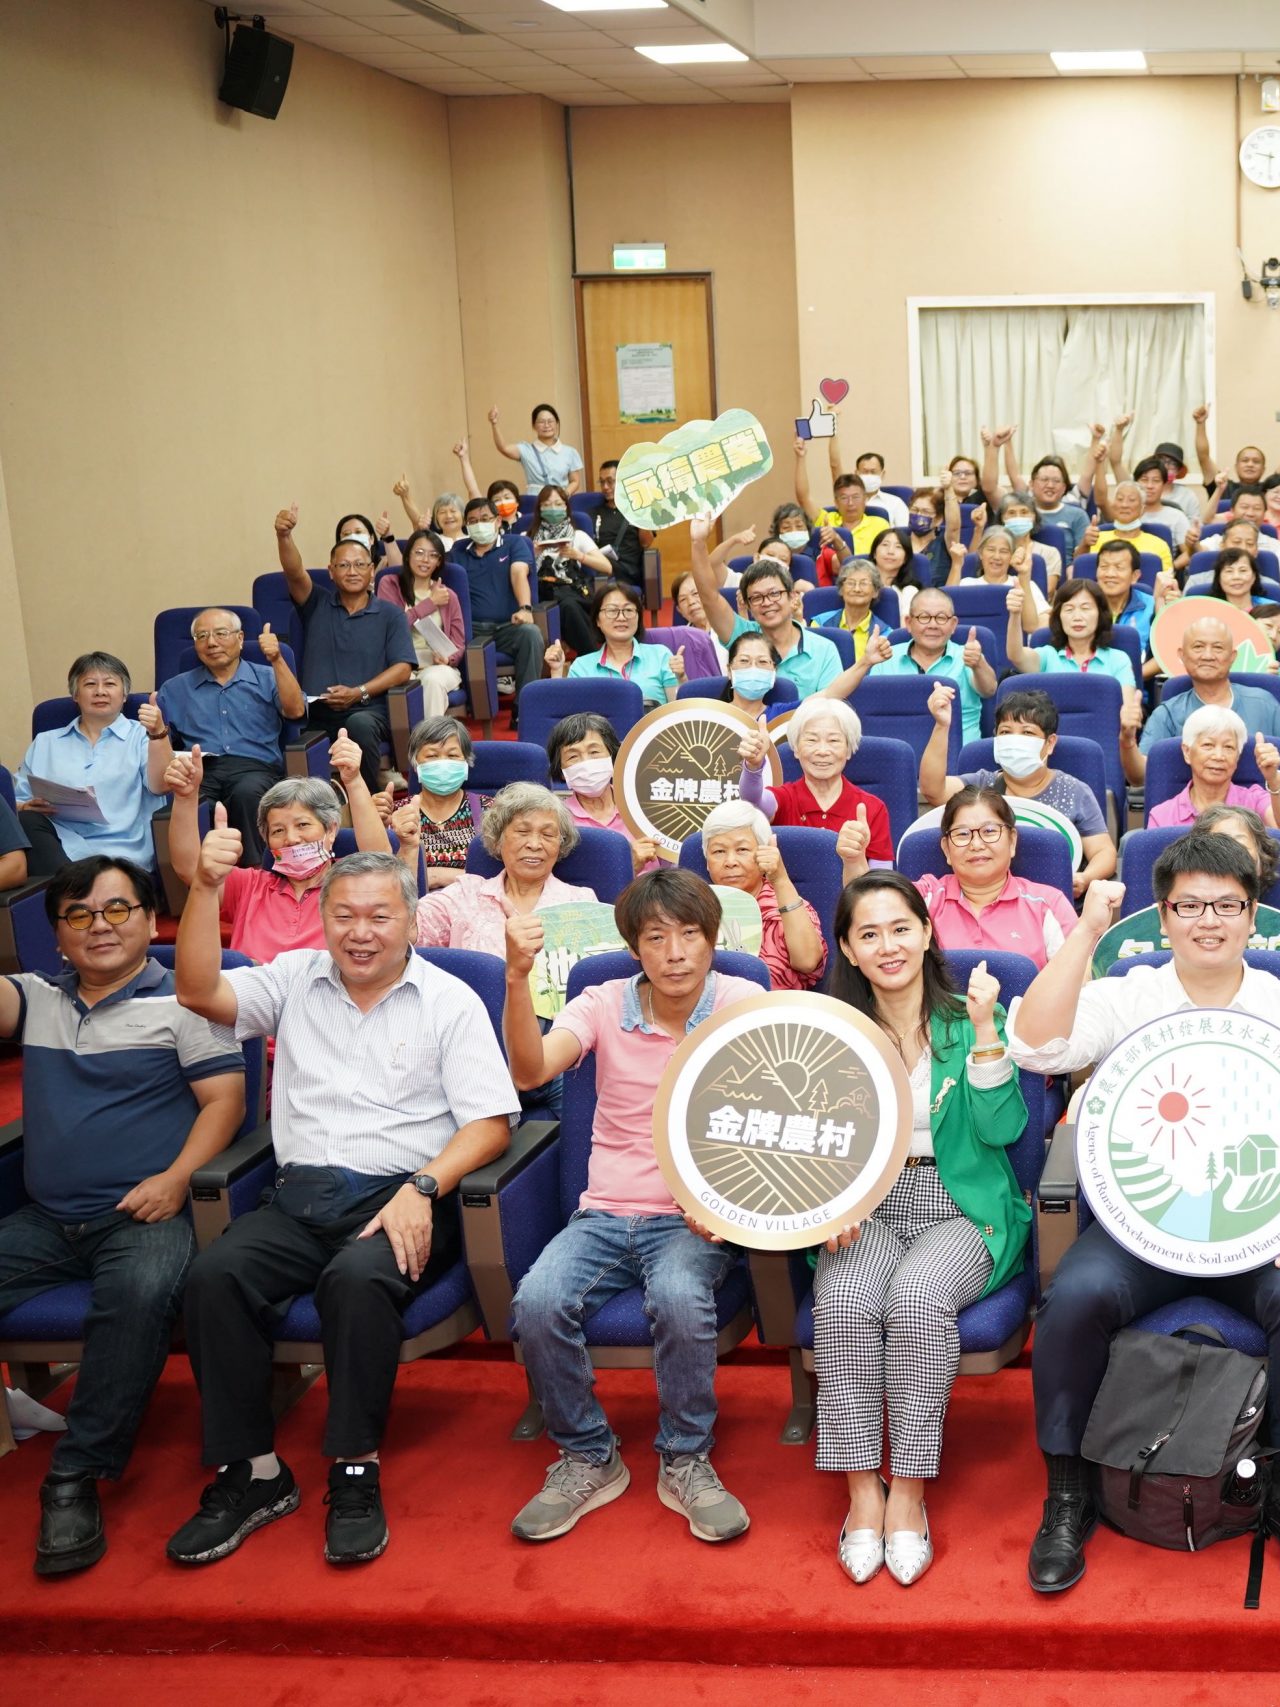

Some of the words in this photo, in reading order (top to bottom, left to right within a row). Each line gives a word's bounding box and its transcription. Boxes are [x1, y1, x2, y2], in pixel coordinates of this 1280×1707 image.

[622, 428, 764, 511] 永續農業
[705, 1104, 857, 1158] 金牌農村
[700, 1190, 758, 1228] GOLDEN
[765, 1208, 832, 1231] VILLAGE
[1085, 1121, 1099, 1165] Agency
[1096, 1179, 1119, 1219] Rural
[1113, 1212, 1184, 1262] Development
[1199, 1251, 1221, 1265] Soil
[1223, 1247, 1247, 1263] and
